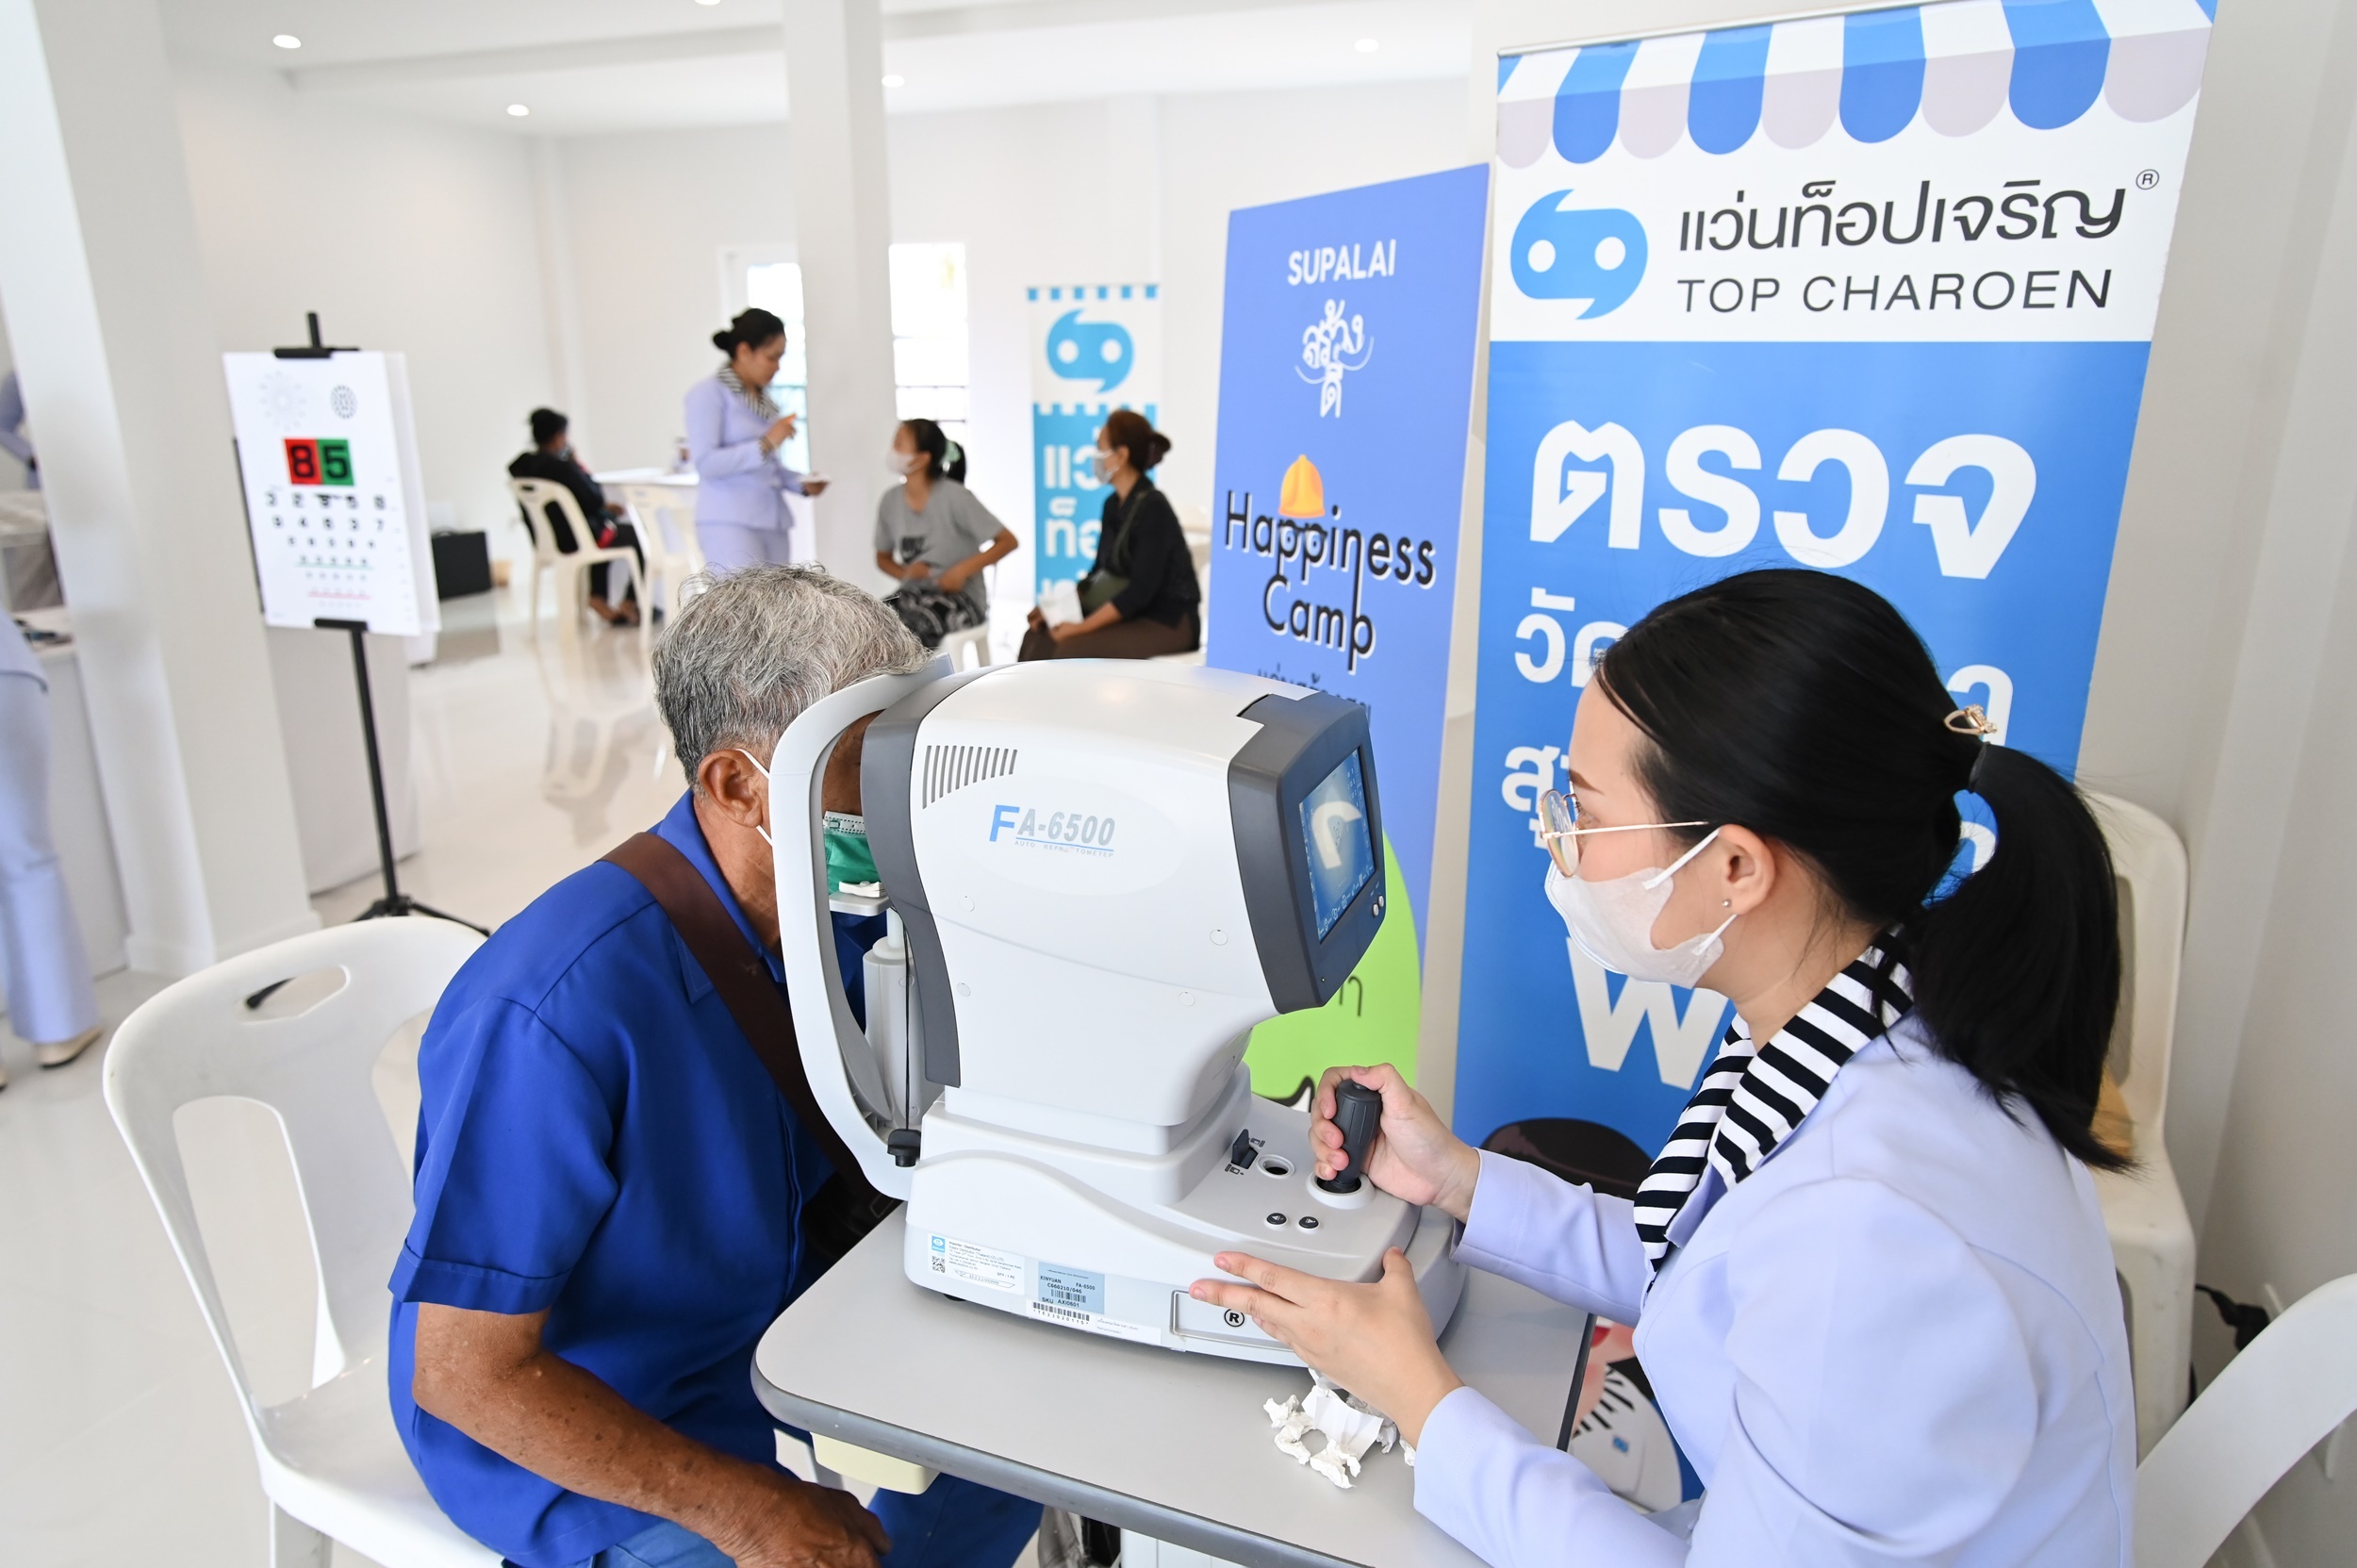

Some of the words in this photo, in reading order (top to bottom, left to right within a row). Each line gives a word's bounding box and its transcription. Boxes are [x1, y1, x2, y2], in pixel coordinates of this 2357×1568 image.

[1679, 179, 2126, 252] แว่นท็อปเจริญ
[1287, 239, 1397, 287] SUPALAI
[1677, 277, 1781, 314] TOP
[1802, 269, 2113, 313] CHAROEN
[1529, 420, 2037, 580] ตรวจ
[1225, 489, 1436, 589] Happiness
[1263, 573, 1376, 677] Camp
[989, 804, 1115, 846] FA-6500
[1014, 840, 1035, 849] AUTO
[1040, 1275, 1062, 1284] XINYUAN
